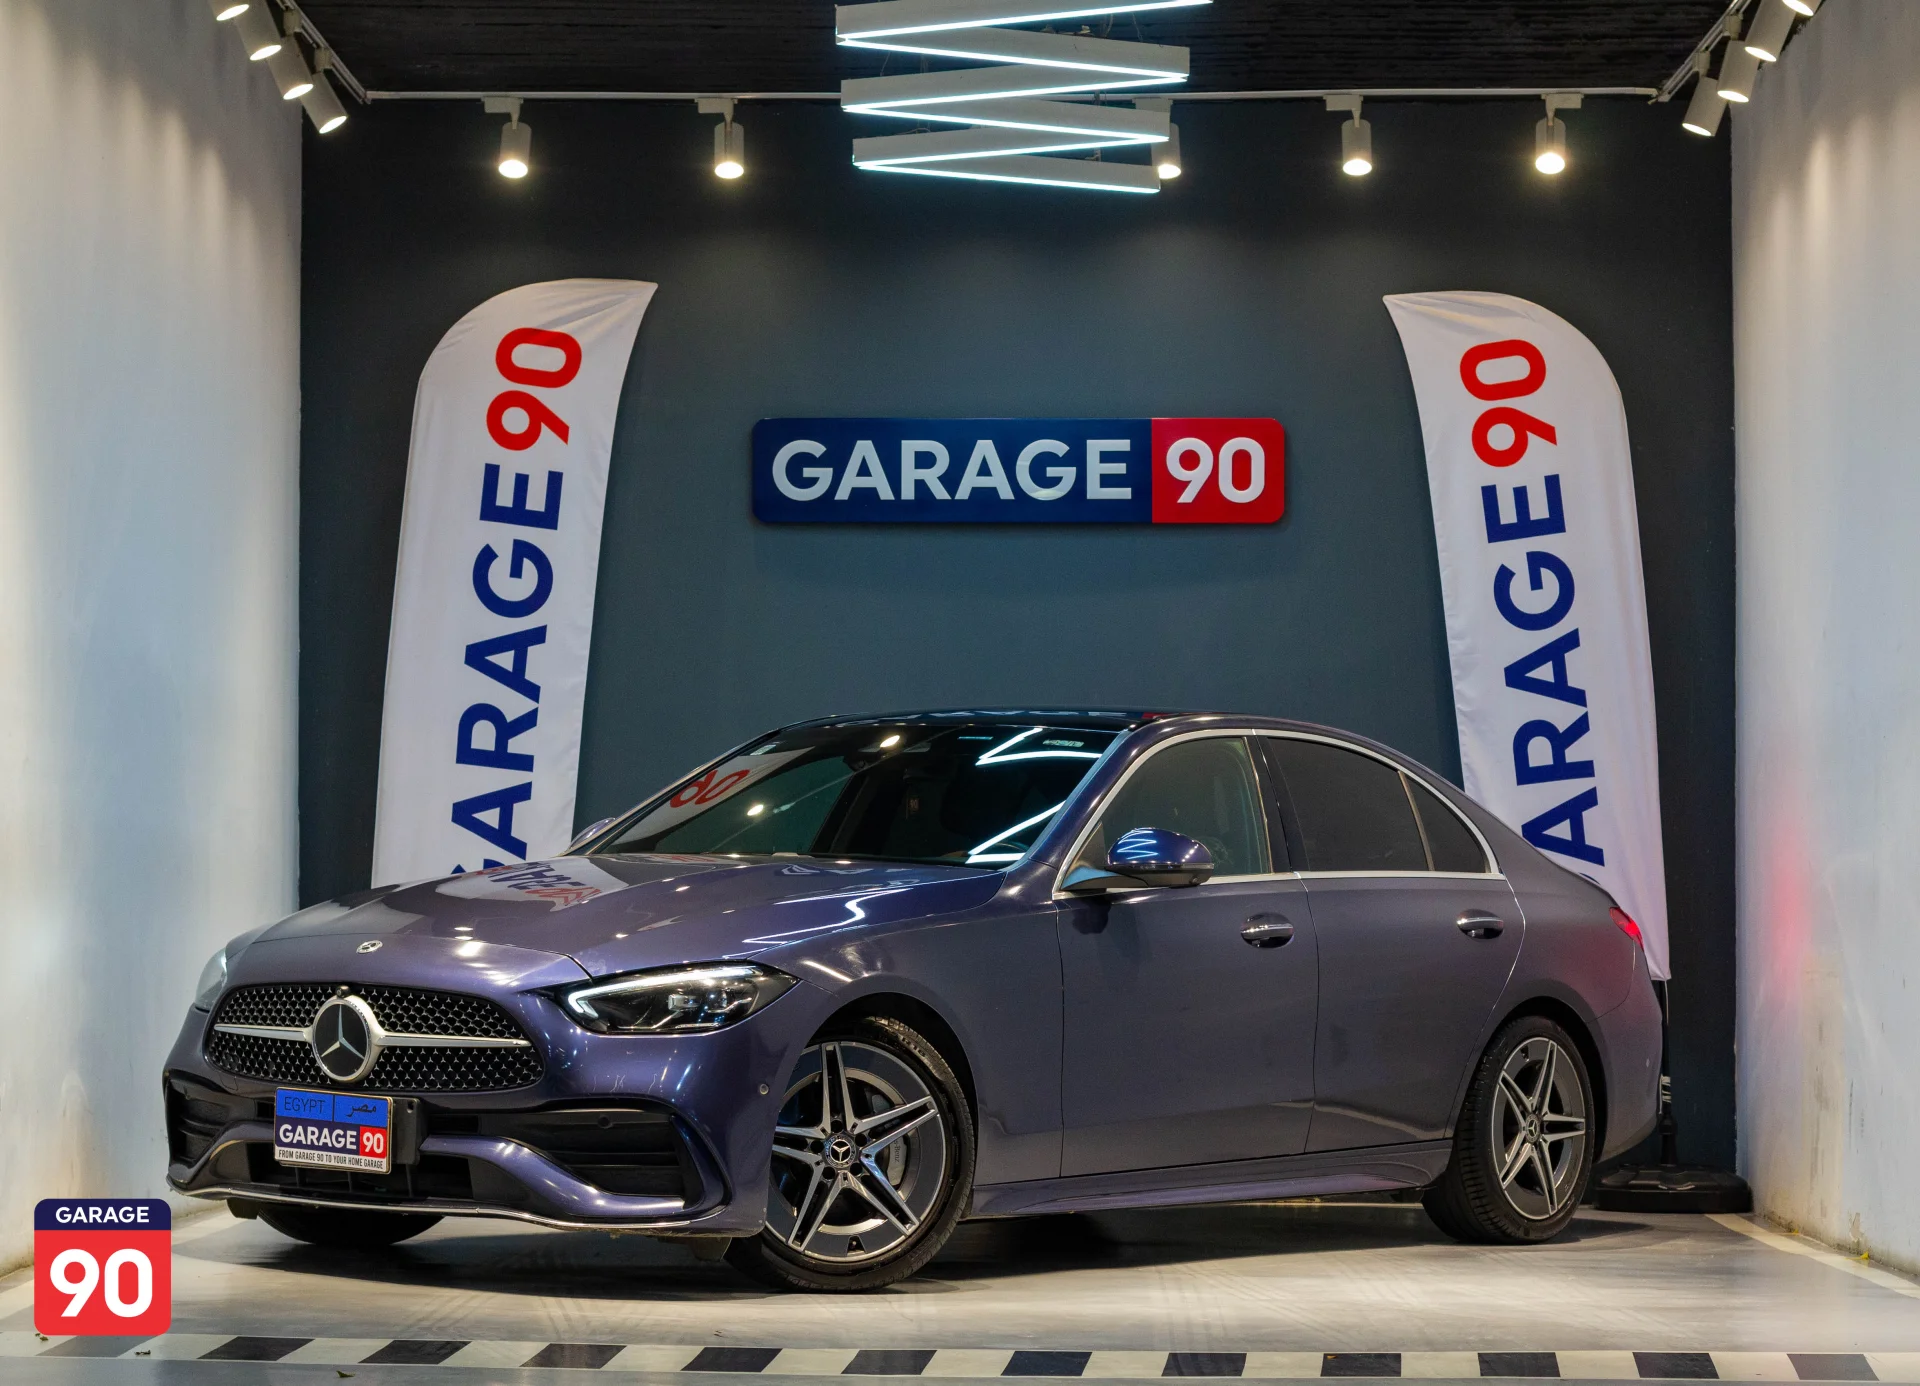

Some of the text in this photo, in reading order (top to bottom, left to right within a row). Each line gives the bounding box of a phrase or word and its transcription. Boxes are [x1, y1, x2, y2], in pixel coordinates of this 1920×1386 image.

[772, 437, 1265, 503] GARAGE 90
[284, 1096, 325, 1114] EGYPT
[346, 1103, 377, 1117] مصر
[279, 1123, 384, 1154] GARAGE 90
[278, 1149, 384, 1169] FROM GARAGE 90 TO YOUR HOME GARAGE
